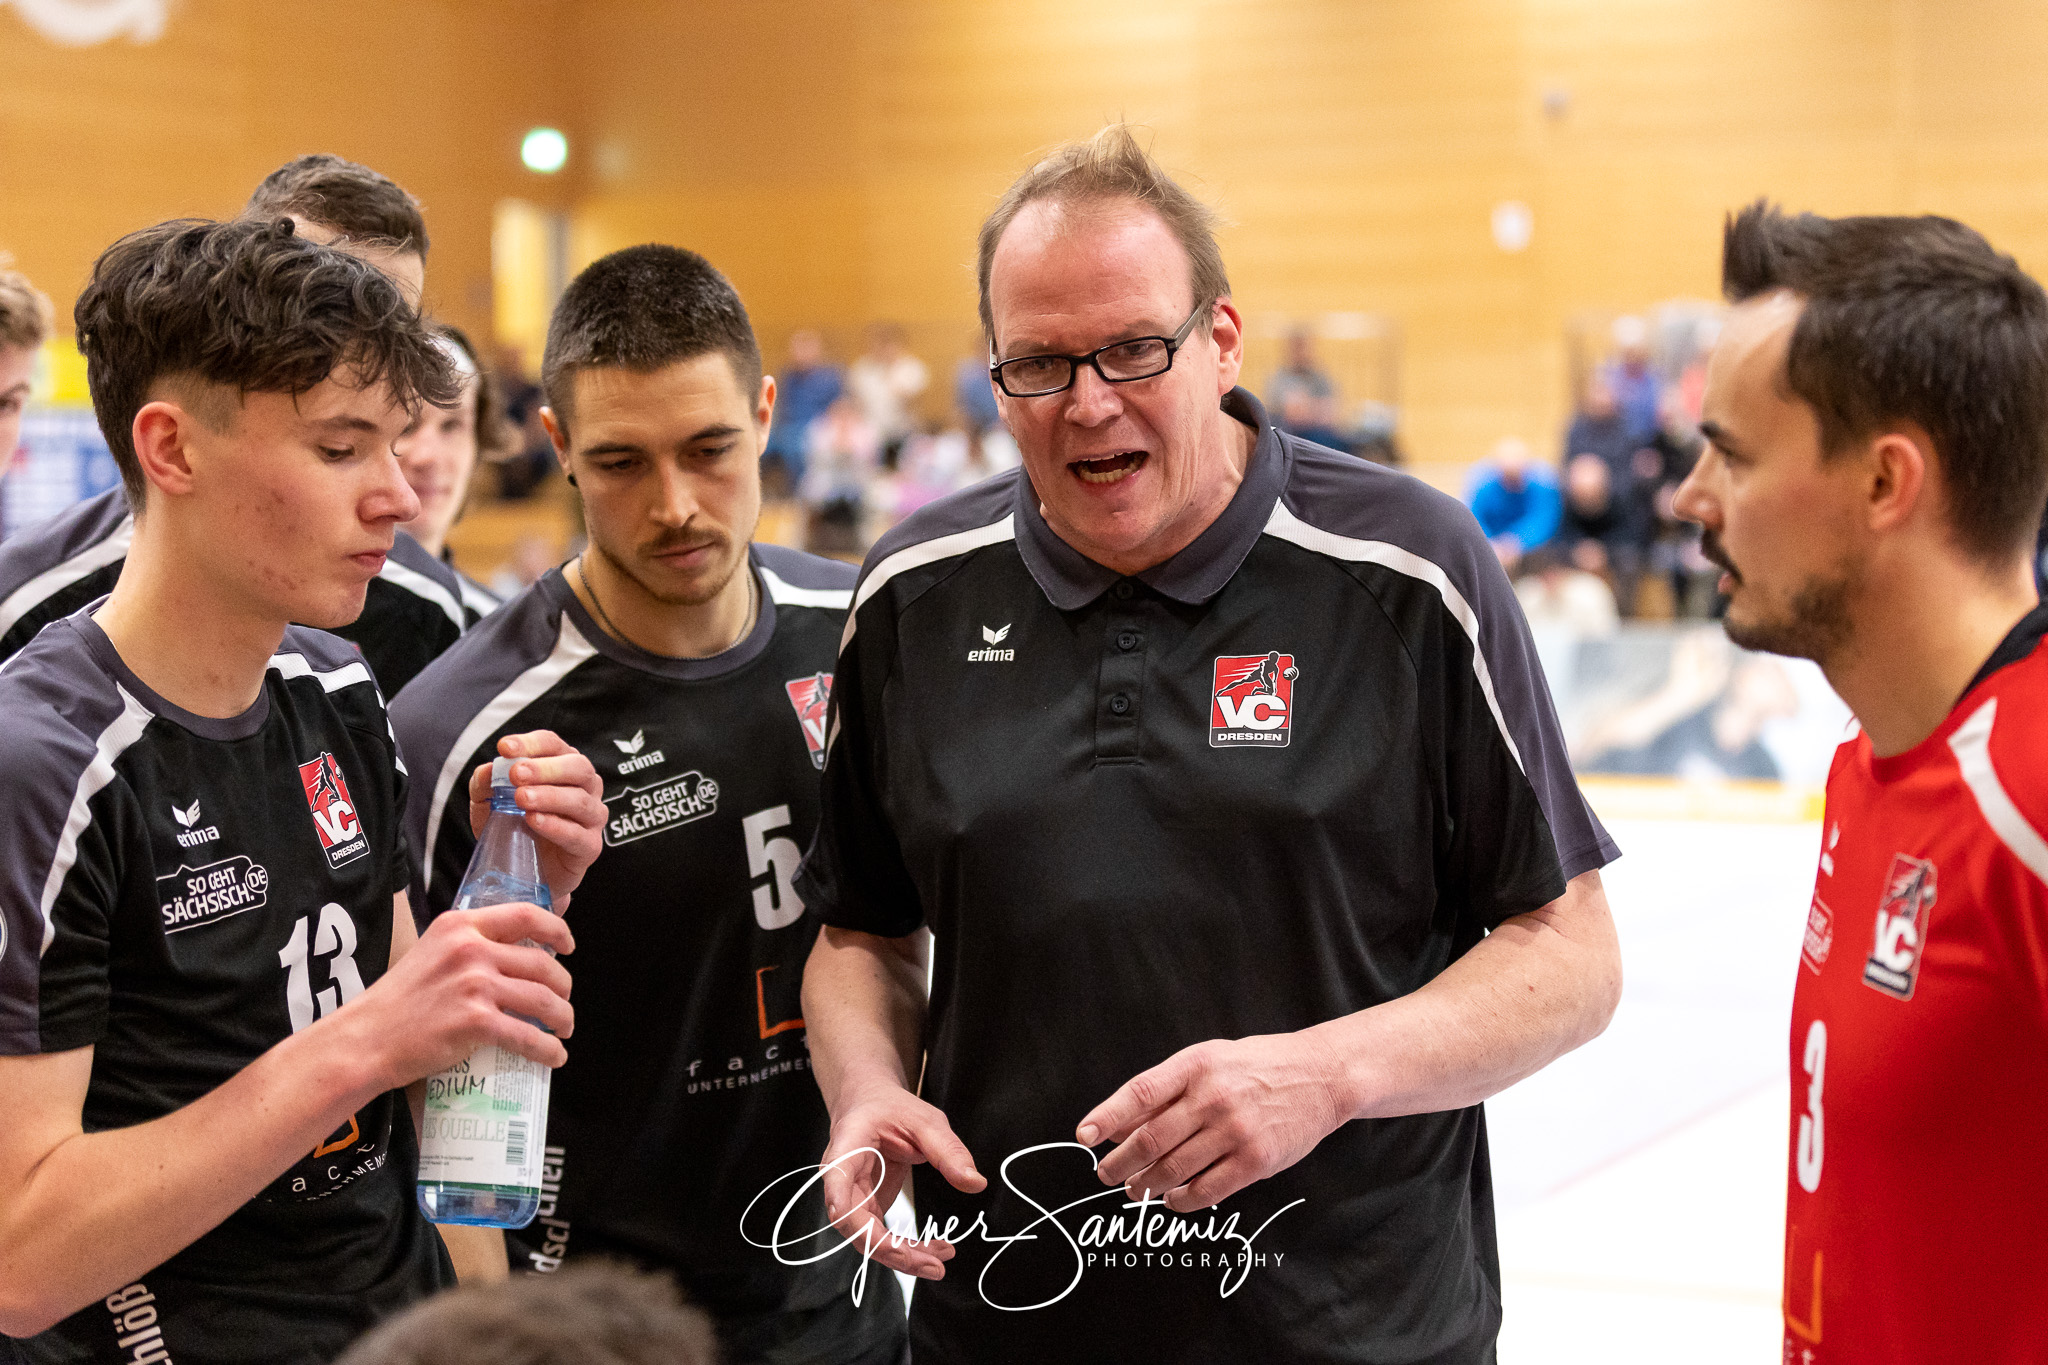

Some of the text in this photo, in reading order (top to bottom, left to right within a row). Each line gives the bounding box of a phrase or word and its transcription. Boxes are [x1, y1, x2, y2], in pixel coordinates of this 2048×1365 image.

[967, 647, 1015, 662] erima
[1215, 695, 1288, 731] VC
[1217, 732, 1282, 742] DRESDEN
[617, 749, 665, 775] erima
[631, 781, 688, 812] SO GEHT
[698, 784, 716, 800] DE
[312, 800, 358, 846] VC
[609, 794, 707, 839] SÄCHSISCH.
[177, 825, 220, 848] erima
[331, 840, 366, 862] DRESDEN
[247, 869, 267, 889] DE
[742, 803, 806, 931] 5
[186, 867, 237, 897] SO GEHT
[161, 883, 255, 926] SÄCHSISCH.
[278, 902, 366, 1035] 13
[440, 1117, 506, 1143] QUELLE
